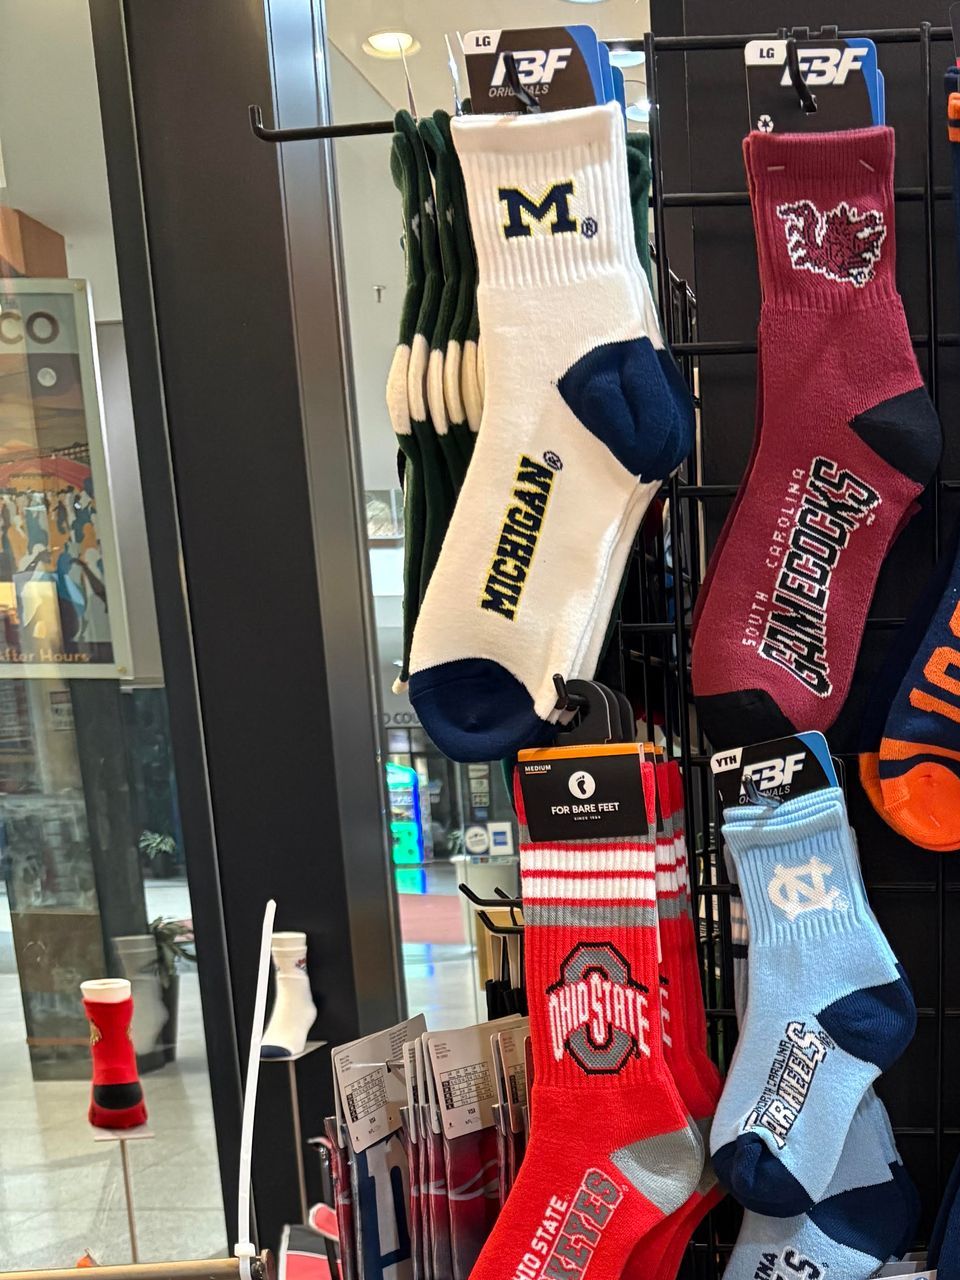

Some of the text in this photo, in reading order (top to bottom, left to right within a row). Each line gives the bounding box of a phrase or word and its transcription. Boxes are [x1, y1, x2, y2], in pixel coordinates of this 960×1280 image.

[475, 35, 492, 47] LG
[759, 47, 775, 59] LG
[479, 453, 557, 622] MICHIGAN
[741, 468, 806, 648] SOUTH CAROLINA
[757, 456, 882, 699] GAMECOCKS
[525, 764, 552, 772] MEDIUM
[715, 755, 738, 768] YTH
[551, 802, 620, 815] FOR BARE FEET
[549, 988, 590, 1062] OHIO
[589, 968, 651, 1059] STATE
[767, 1040, 792, 1088] CAROLINA
[776, 1021, 828, 1114] HEELS
[531, 1194, 569, 1256] STATE
